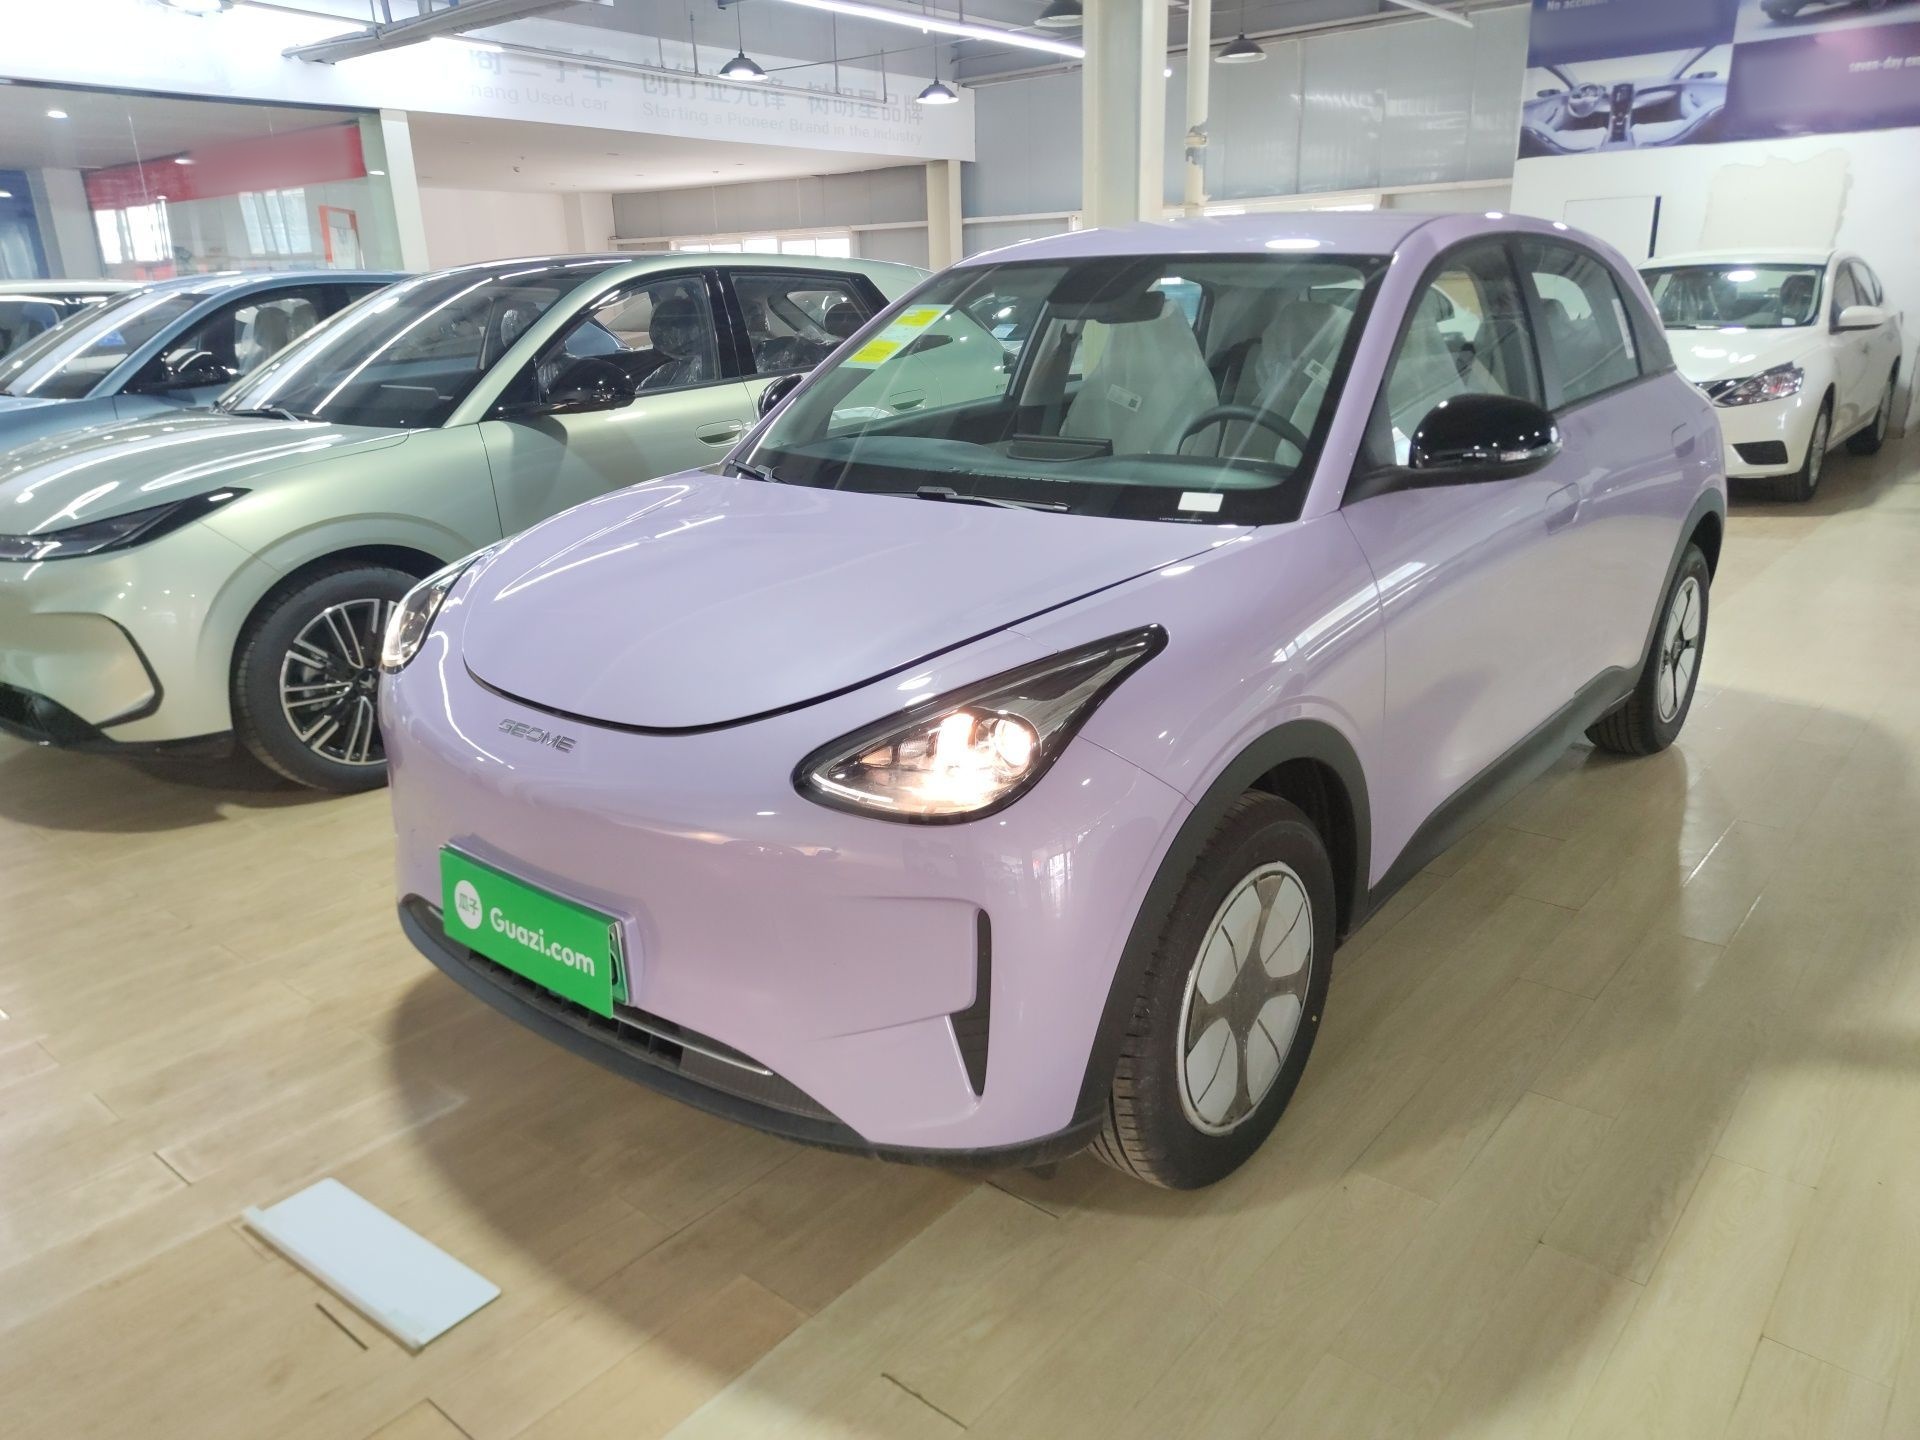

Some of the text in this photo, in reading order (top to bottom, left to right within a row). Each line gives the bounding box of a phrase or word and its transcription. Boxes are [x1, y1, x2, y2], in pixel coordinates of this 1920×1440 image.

[526, 86, 575, 108] Used
[581, 97, 610, 112] car
[642, 101, 708, 126] Starting
[714, 112, 723, 125] a
[727, 111, 785, 131] Pioneer
[789, 117, 830, 136] Brand
[834, 123, 845, 136] in
[849, 125, 870, 139] the
[498, 718, 578, 754] GEOME
[490, 907, 596, 977] Guazi.com
